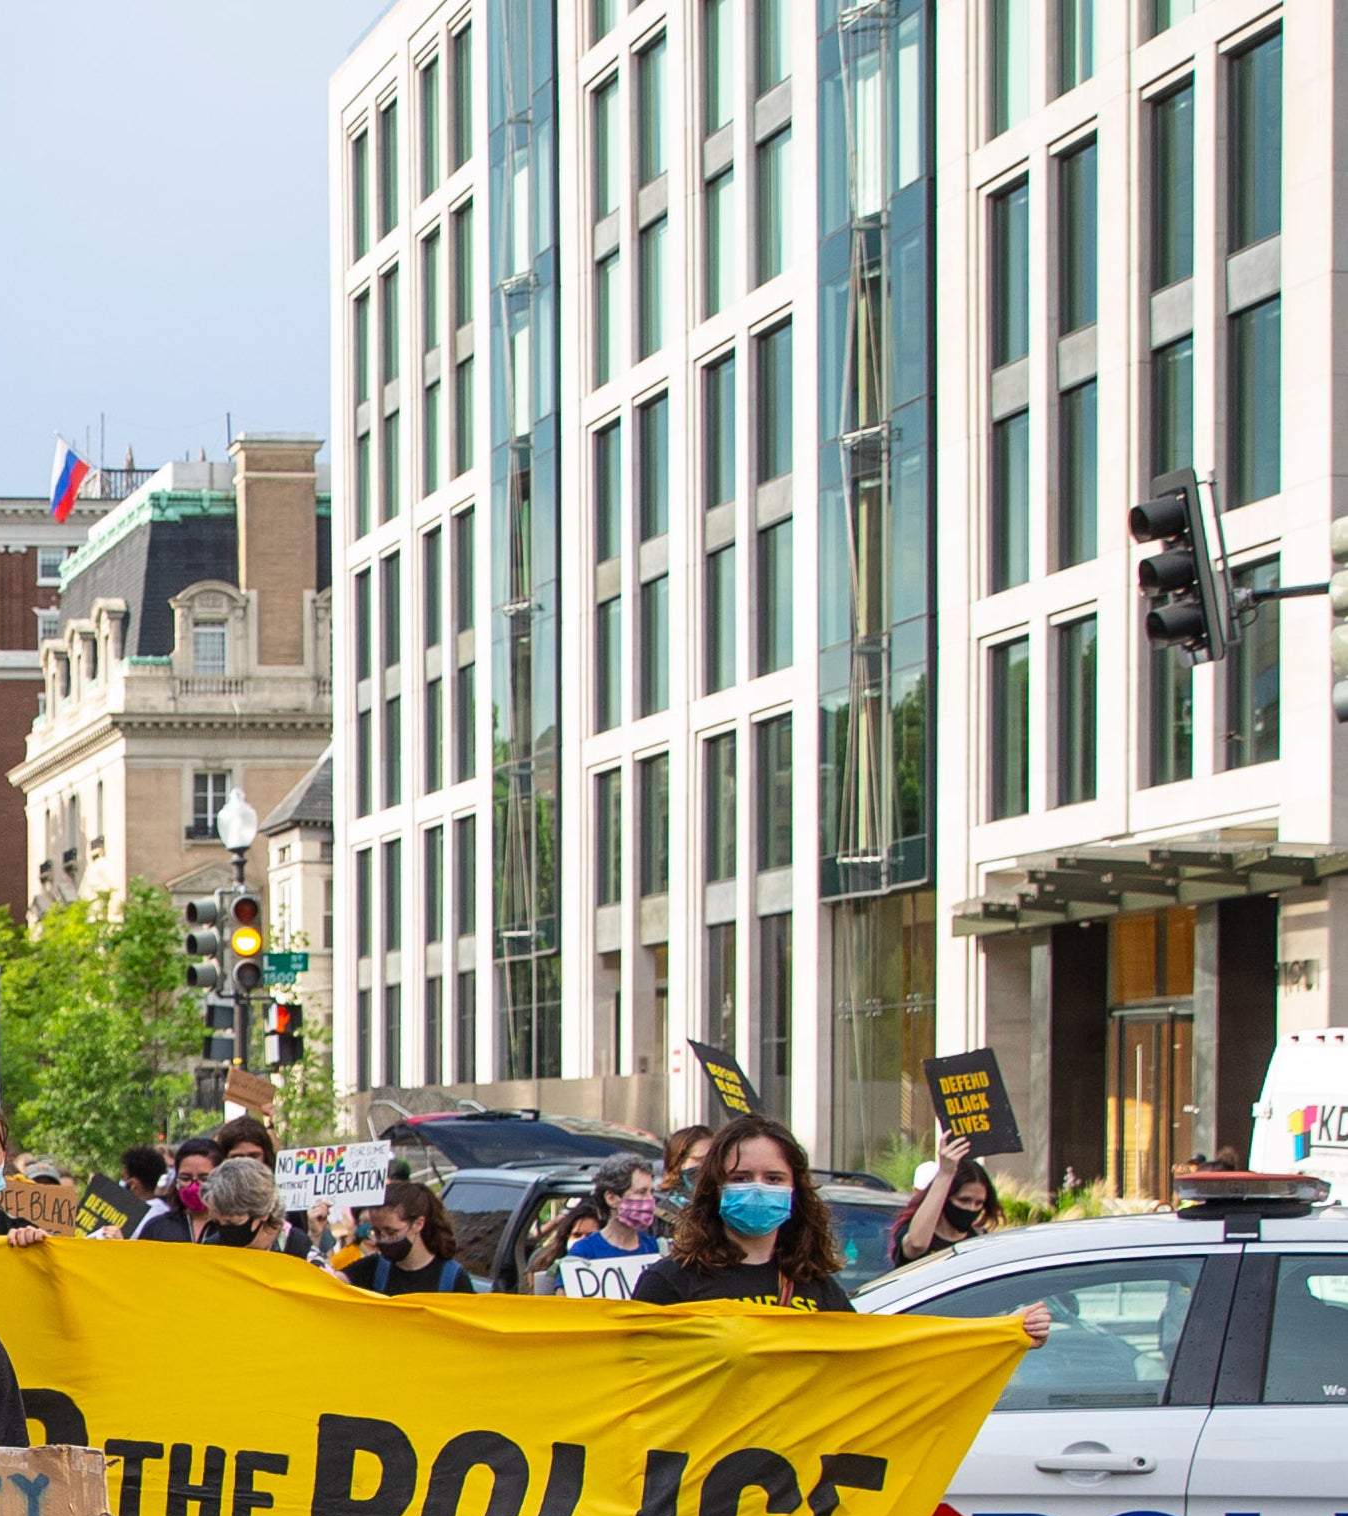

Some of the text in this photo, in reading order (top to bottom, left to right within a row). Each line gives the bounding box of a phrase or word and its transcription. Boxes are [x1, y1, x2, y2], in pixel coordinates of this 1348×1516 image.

[263, 955, 276, 971] L
[939, 1071, 990, 1095] DEFEND
[945, 1093, 990, 1116] BLACK
[951, 1113, 991, 1136] LIVES
[277, 1154, 294, 1175] NO
[295, 1146, 347, 1175] PRIDE
[313, 1168, 387, 1196] LIBERATION
[30, 1190, 76, 1228] BLACK
[75, 1208, 99, 1232] THE
[84, 1193, 128, 1229] DEFUND
[1322, 1385, 1348, 1396] We
